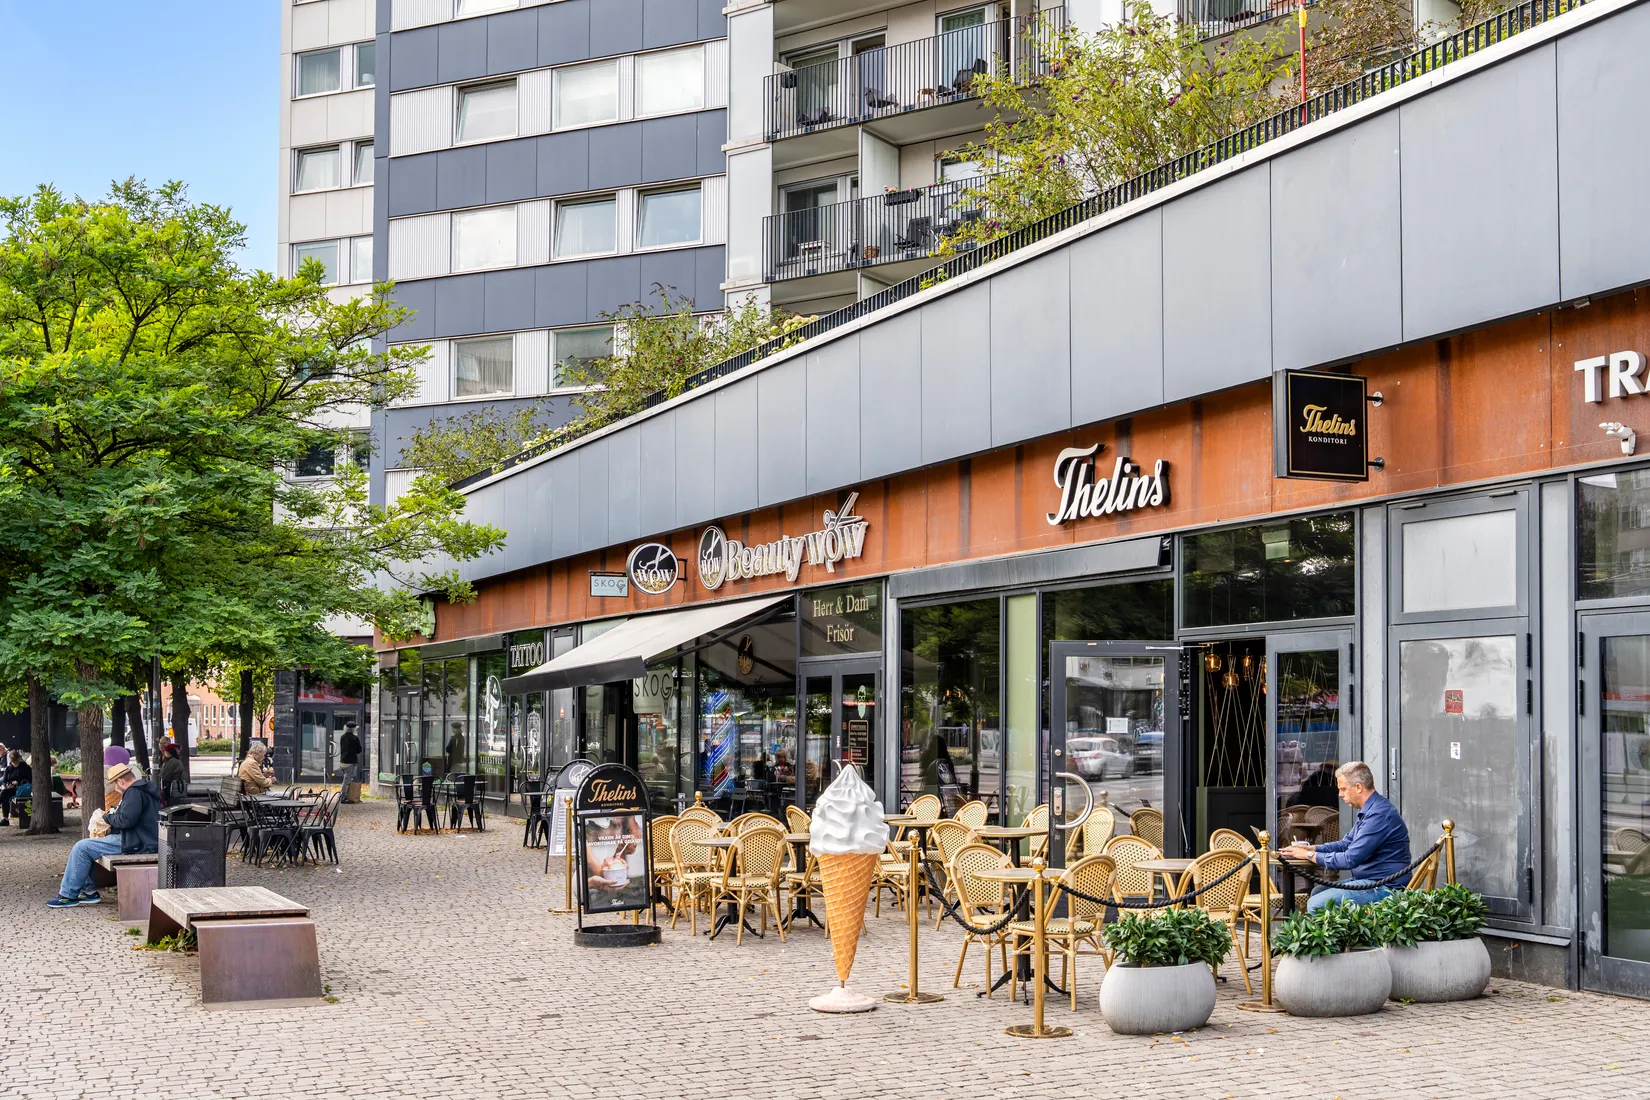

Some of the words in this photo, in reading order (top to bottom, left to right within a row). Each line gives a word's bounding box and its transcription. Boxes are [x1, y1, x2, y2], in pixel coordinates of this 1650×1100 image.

[1574, 350, 1650, 403] TR
[1300, 404, 1356, 436] Thelins
[1308, 436, 1347, 445] KONDITORI
[1047, 443, 1168, 525] Thelins
[725, 536, 805, 582] Beauty
[594, 579, 625, 590] SKOG
[813, 600, 833, 617] Herr
[836, 596, 843, 614] &
[846, 594, 869, 613] Dam
[827, 624, 854, 643] Frisör
[510, 642, 544, 668] TATTOO
[634, 673, 673, 700] SKOG
[480, 755, 503, 765] LIFESTYLE
[588, 779, 636, 803] Thelins
